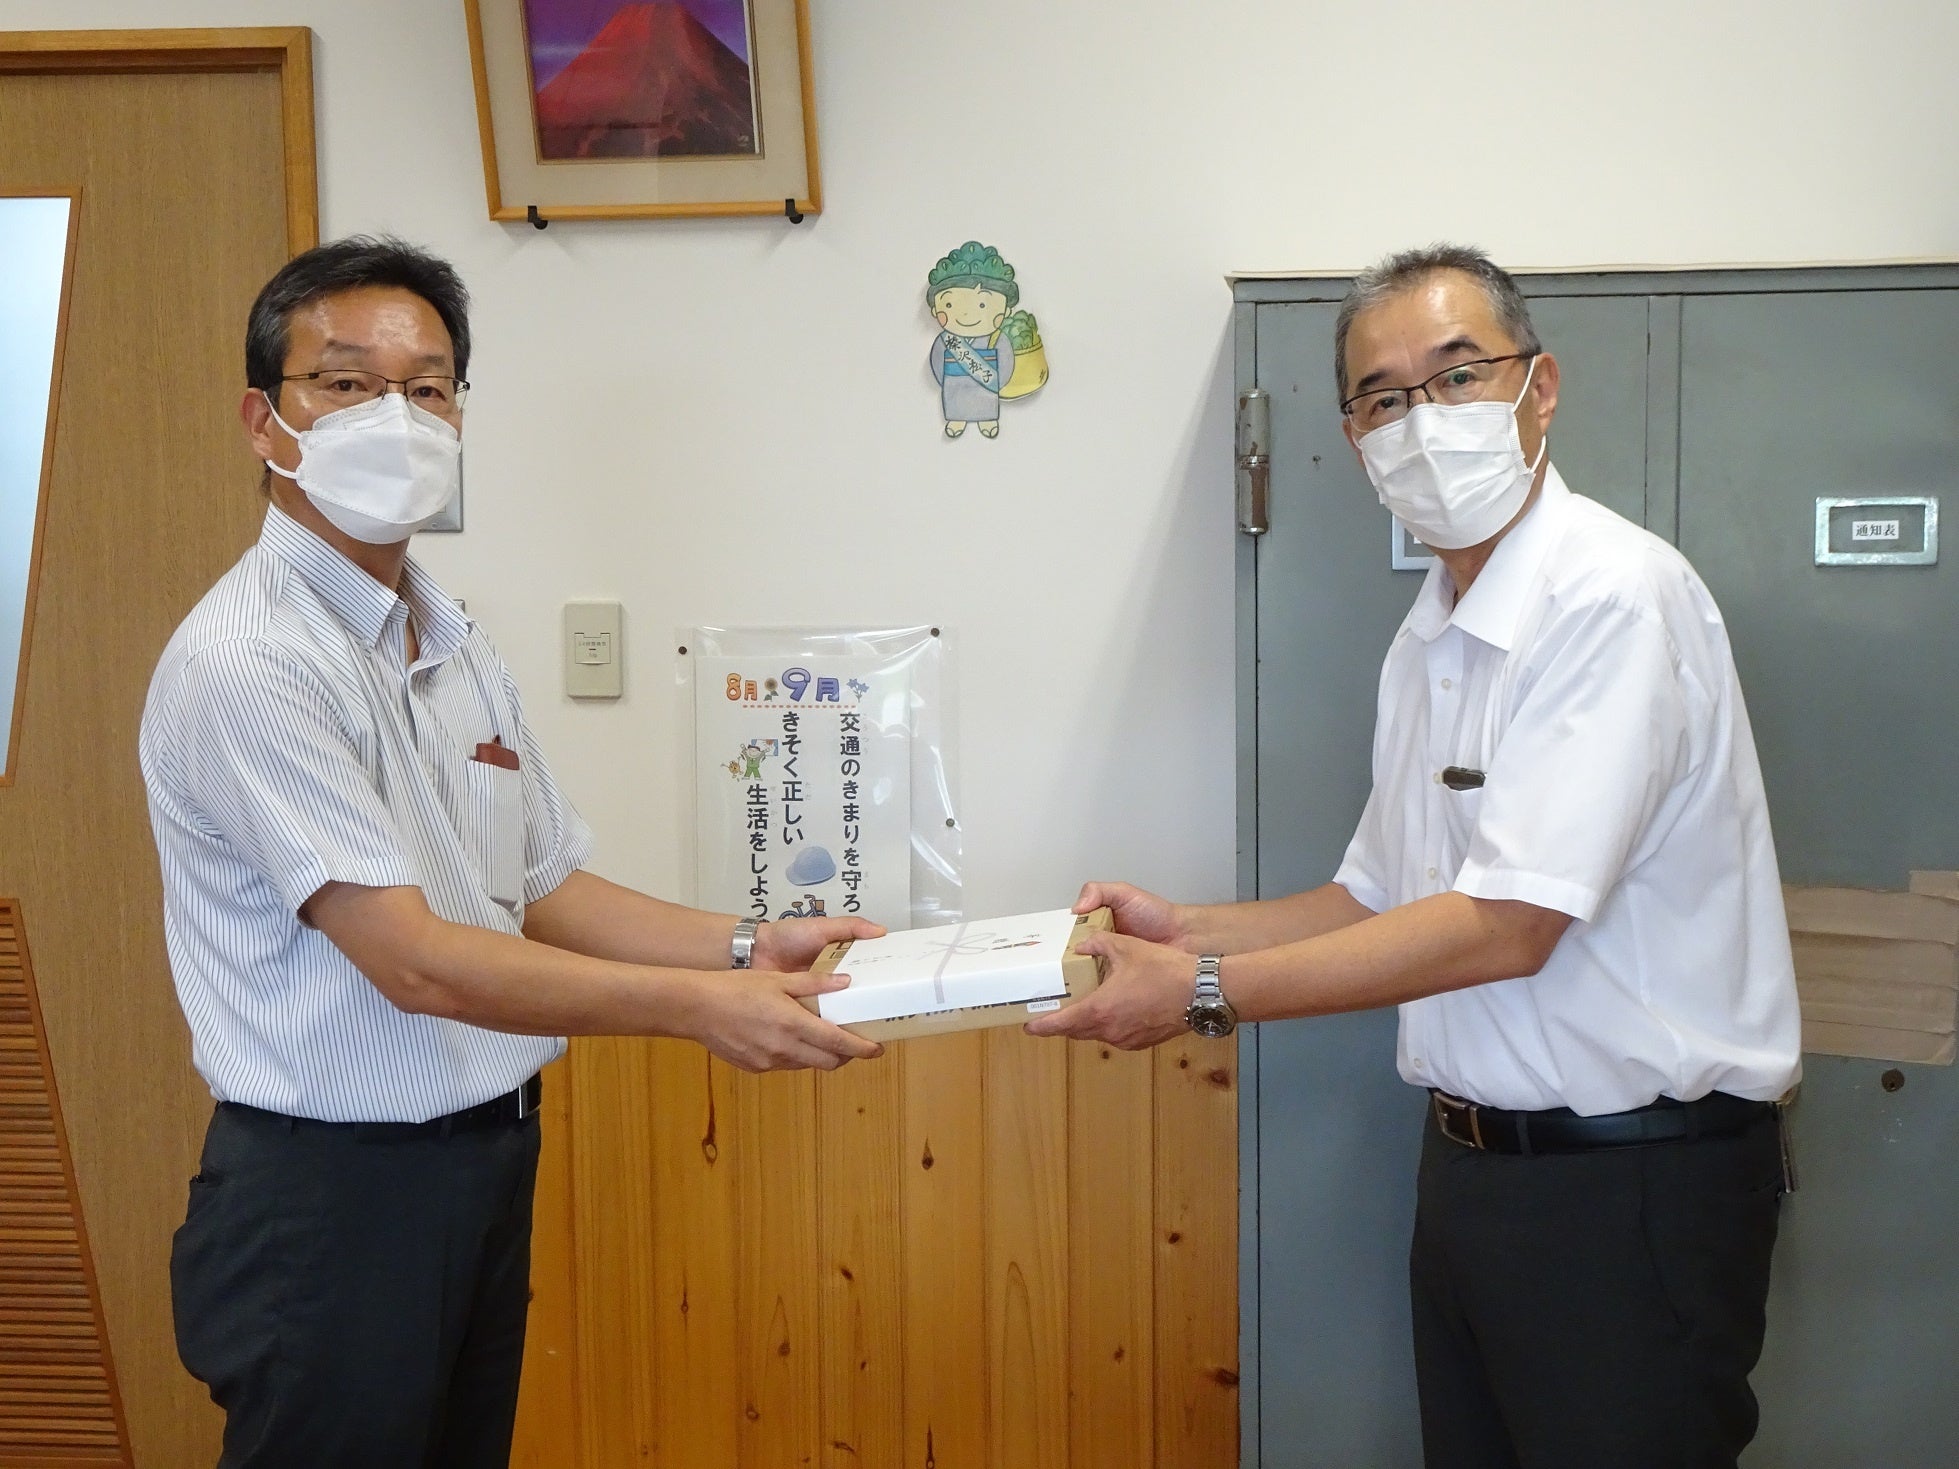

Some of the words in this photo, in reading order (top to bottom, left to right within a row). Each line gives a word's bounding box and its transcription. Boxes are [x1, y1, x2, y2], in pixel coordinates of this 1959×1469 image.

[1855, 523, 1897, 537] 通知表
[726, 672, 758, 702] 8月
[781, 667, 840, 703] 9月
[781, 711, 804, 846] きそく正しい
[746, 783, 769, 918] 生活をしよう
